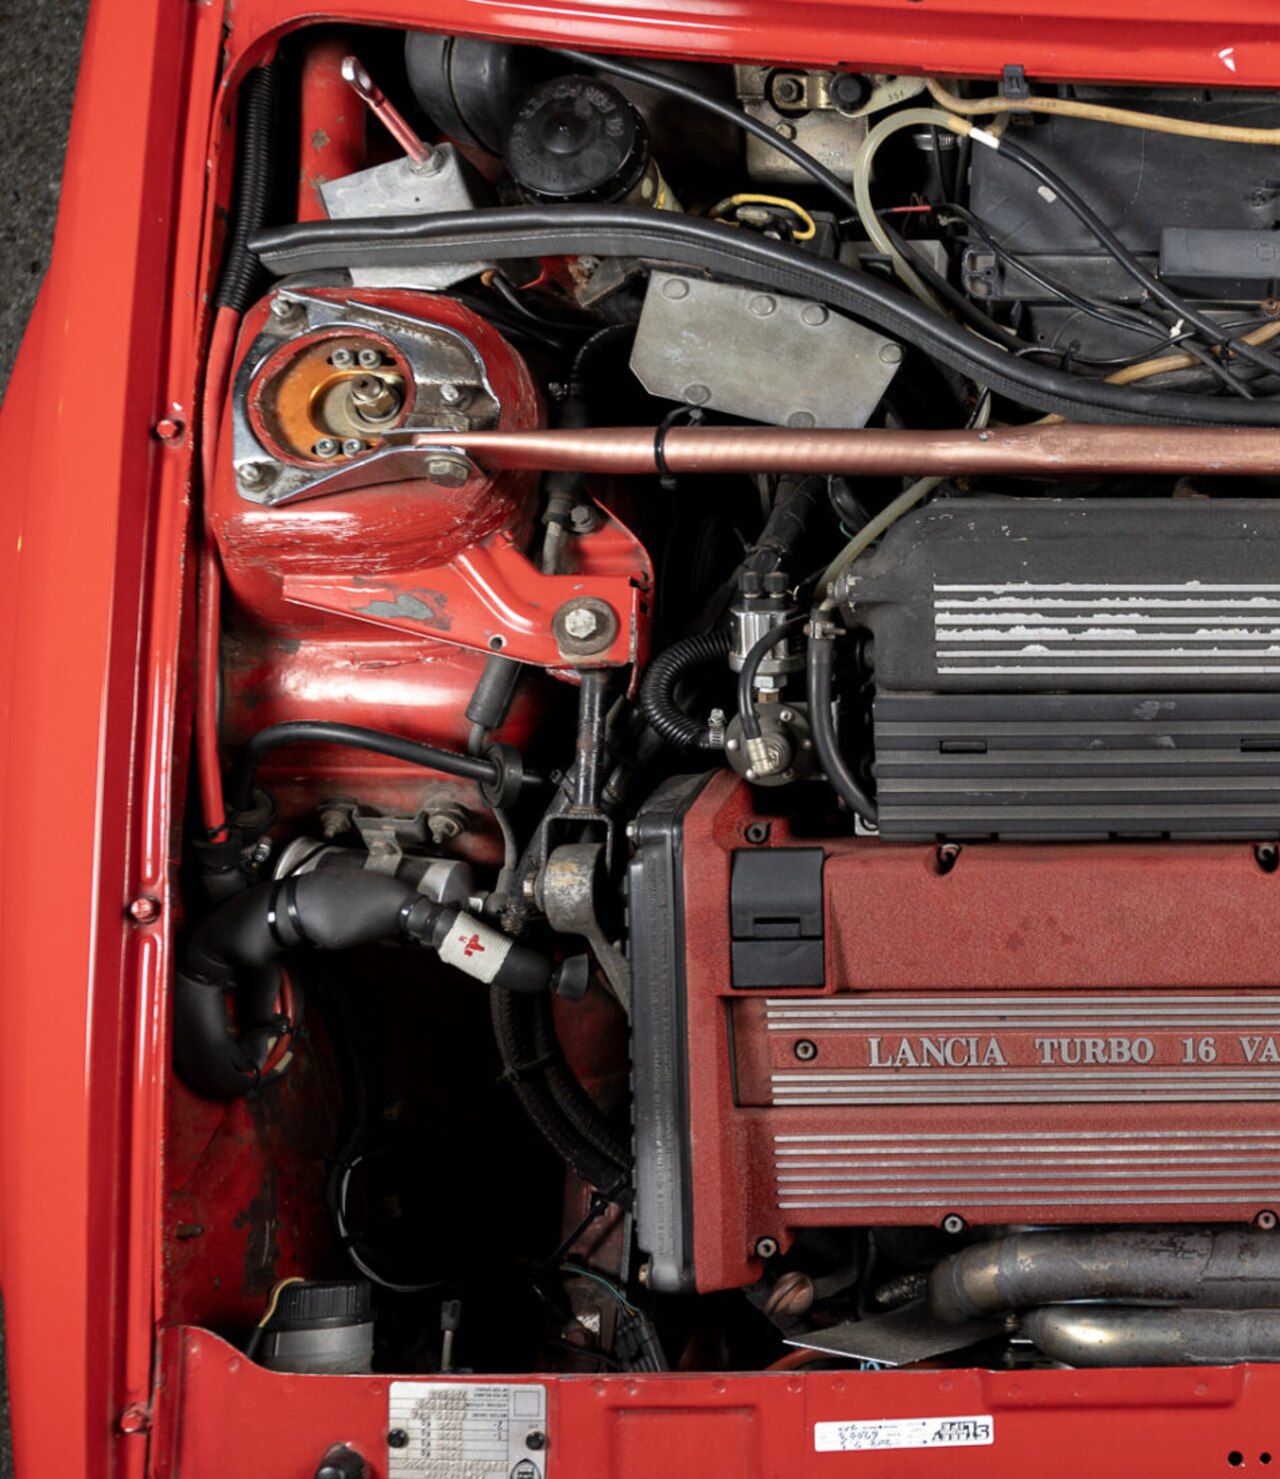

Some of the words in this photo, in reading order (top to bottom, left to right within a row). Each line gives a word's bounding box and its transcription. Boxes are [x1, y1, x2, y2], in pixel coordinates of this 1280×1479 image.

[868, 1037, 1007, 1067] LANCIA
[1034, 1037, 1154, 1065] TURBO
[1181, 1037, 1217, 1063] 16
